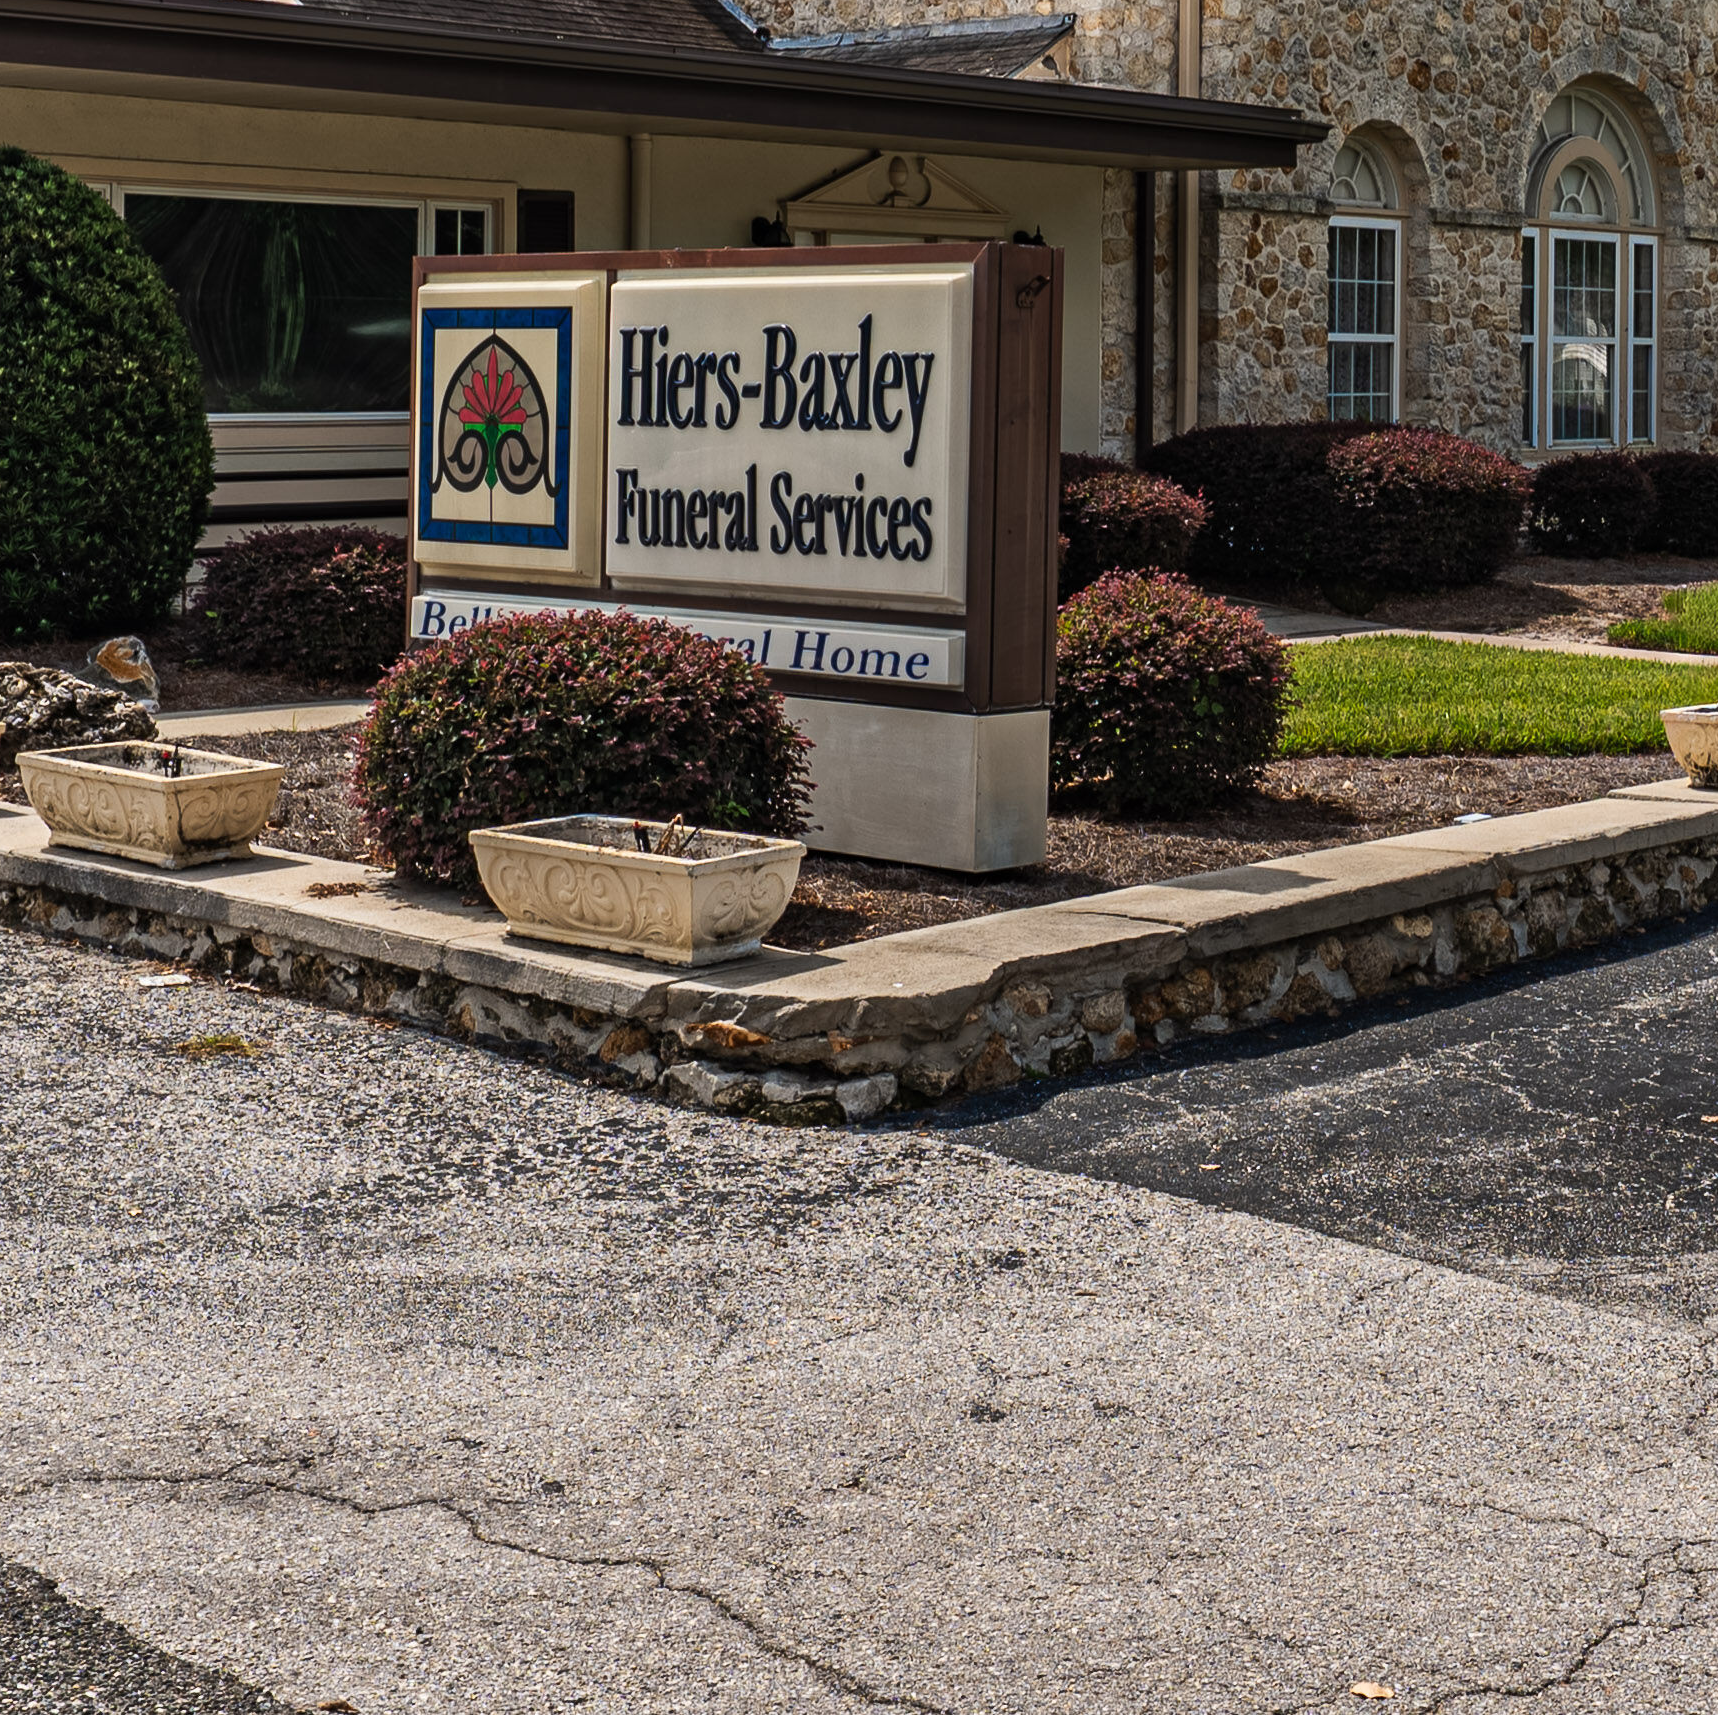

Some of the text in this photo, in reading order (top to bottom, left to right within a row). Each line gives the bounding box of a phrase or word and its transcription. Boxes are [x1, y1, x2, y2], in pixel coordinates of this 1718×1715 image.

[617, 312, 935, 467] Hiers-Baxley
[615, 463, 933, 562] Funeral Services
[789, 630, 930, 680] Home
